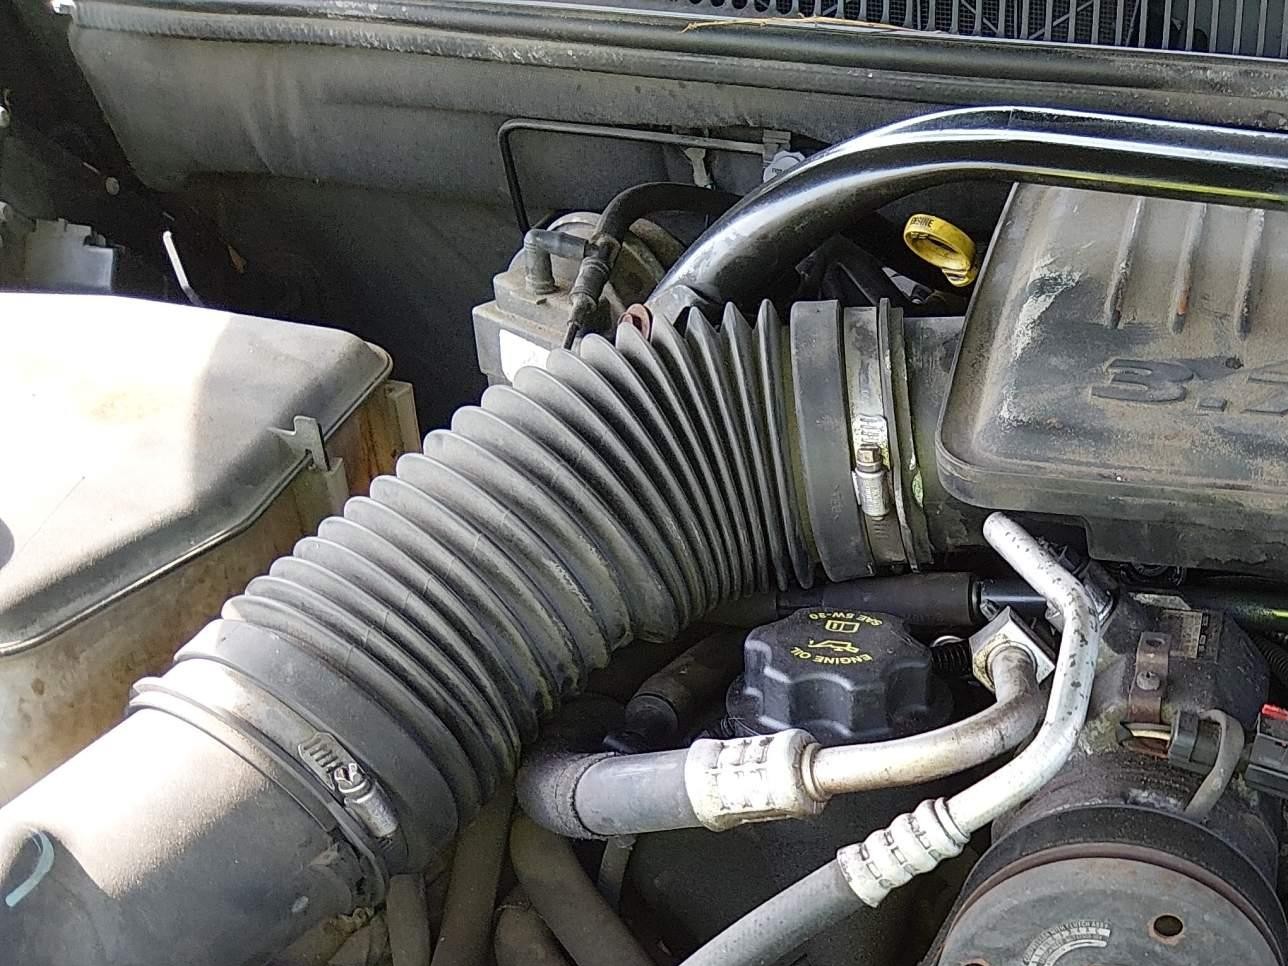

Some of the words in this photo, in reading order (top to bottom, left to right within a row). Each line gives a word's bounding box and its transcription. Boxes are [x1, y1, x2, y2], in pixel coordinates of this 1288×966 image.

[856, 613, 883, 627] SAE
[790, 646, 812, 659] OIL
[814, 652, 873, 665] ENGINE
